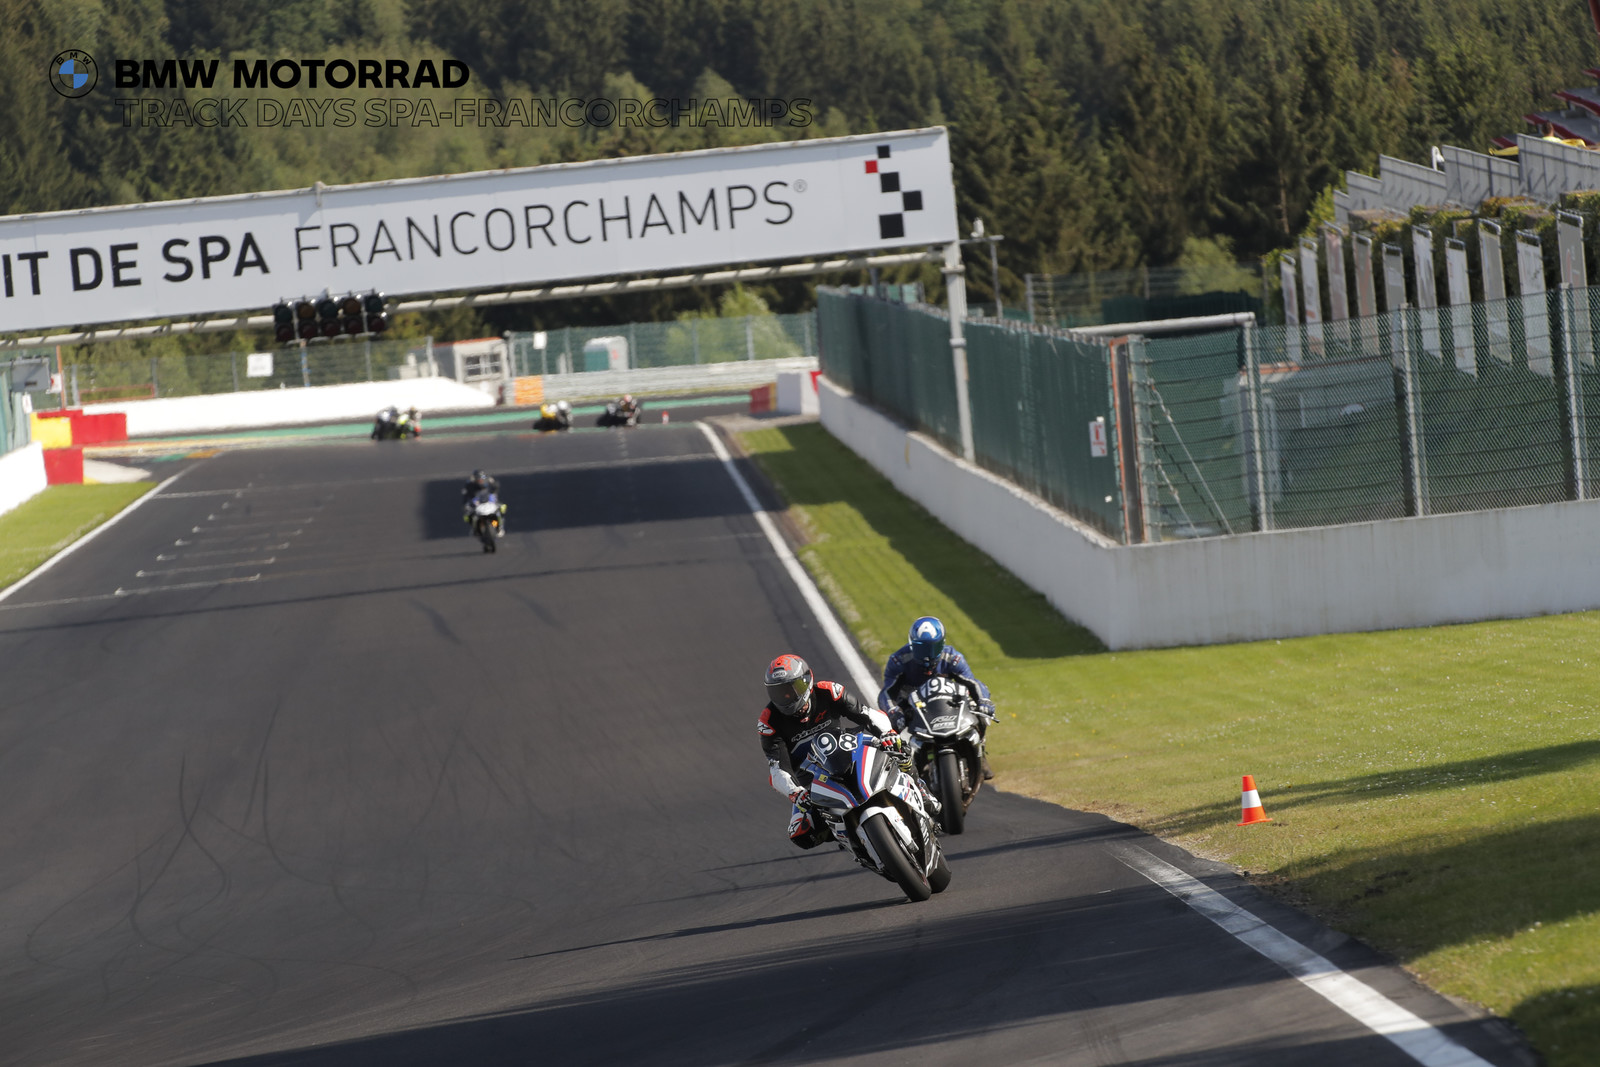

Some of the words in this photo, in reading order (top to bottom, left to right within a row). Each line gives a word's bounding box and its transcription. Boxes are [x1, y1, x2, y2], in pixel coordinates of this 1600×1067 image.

[2, 251, 49, 298] IT
[70, 243, 142, 292] DE
[162, 232, 270, 283] SPA
